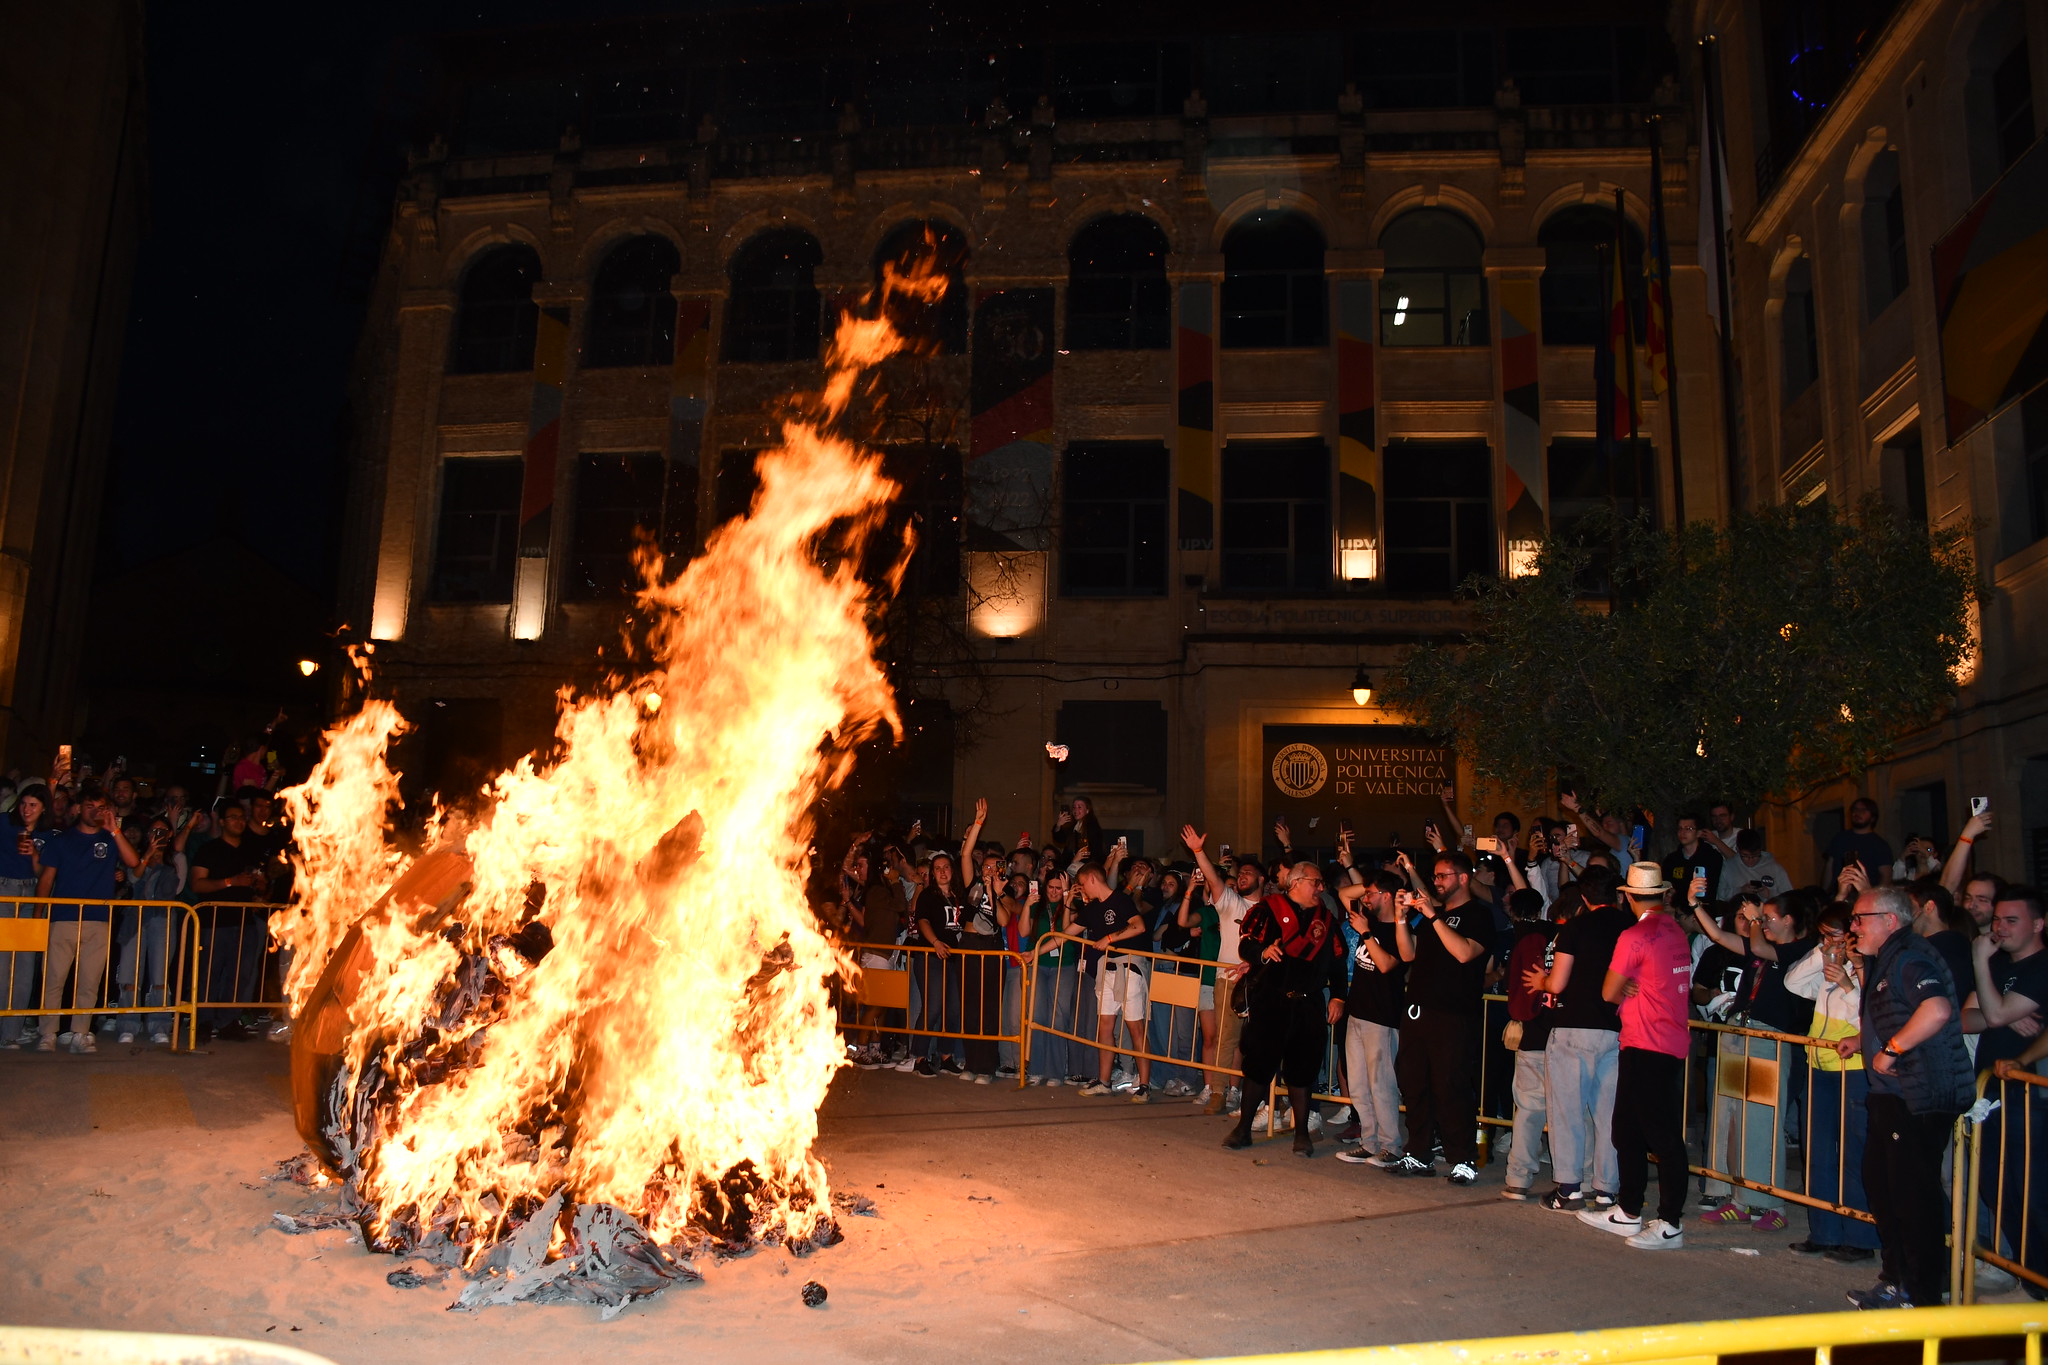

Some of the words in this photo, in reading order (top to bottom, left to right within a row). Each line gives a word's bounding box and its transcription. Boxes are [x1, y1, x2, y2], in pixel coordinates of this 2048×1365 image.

[1179, 538, 1213, 550] UPV
[1340, 538, 1376, 550] UPV
[1508, 539, 1544, 552] UPV
[1210, 609, 1265, 623] ESCOLA
[1379, 608, 1455, 623] SUPERIOR
[1335, 748, 1446, 762] UNIVERSITAT
[1337, 762, 1446, 778] POLITÈCNICA
[1335, 781, 1356, 795] DE
[1365, 777, 1445, 795] VALÈNCIA
